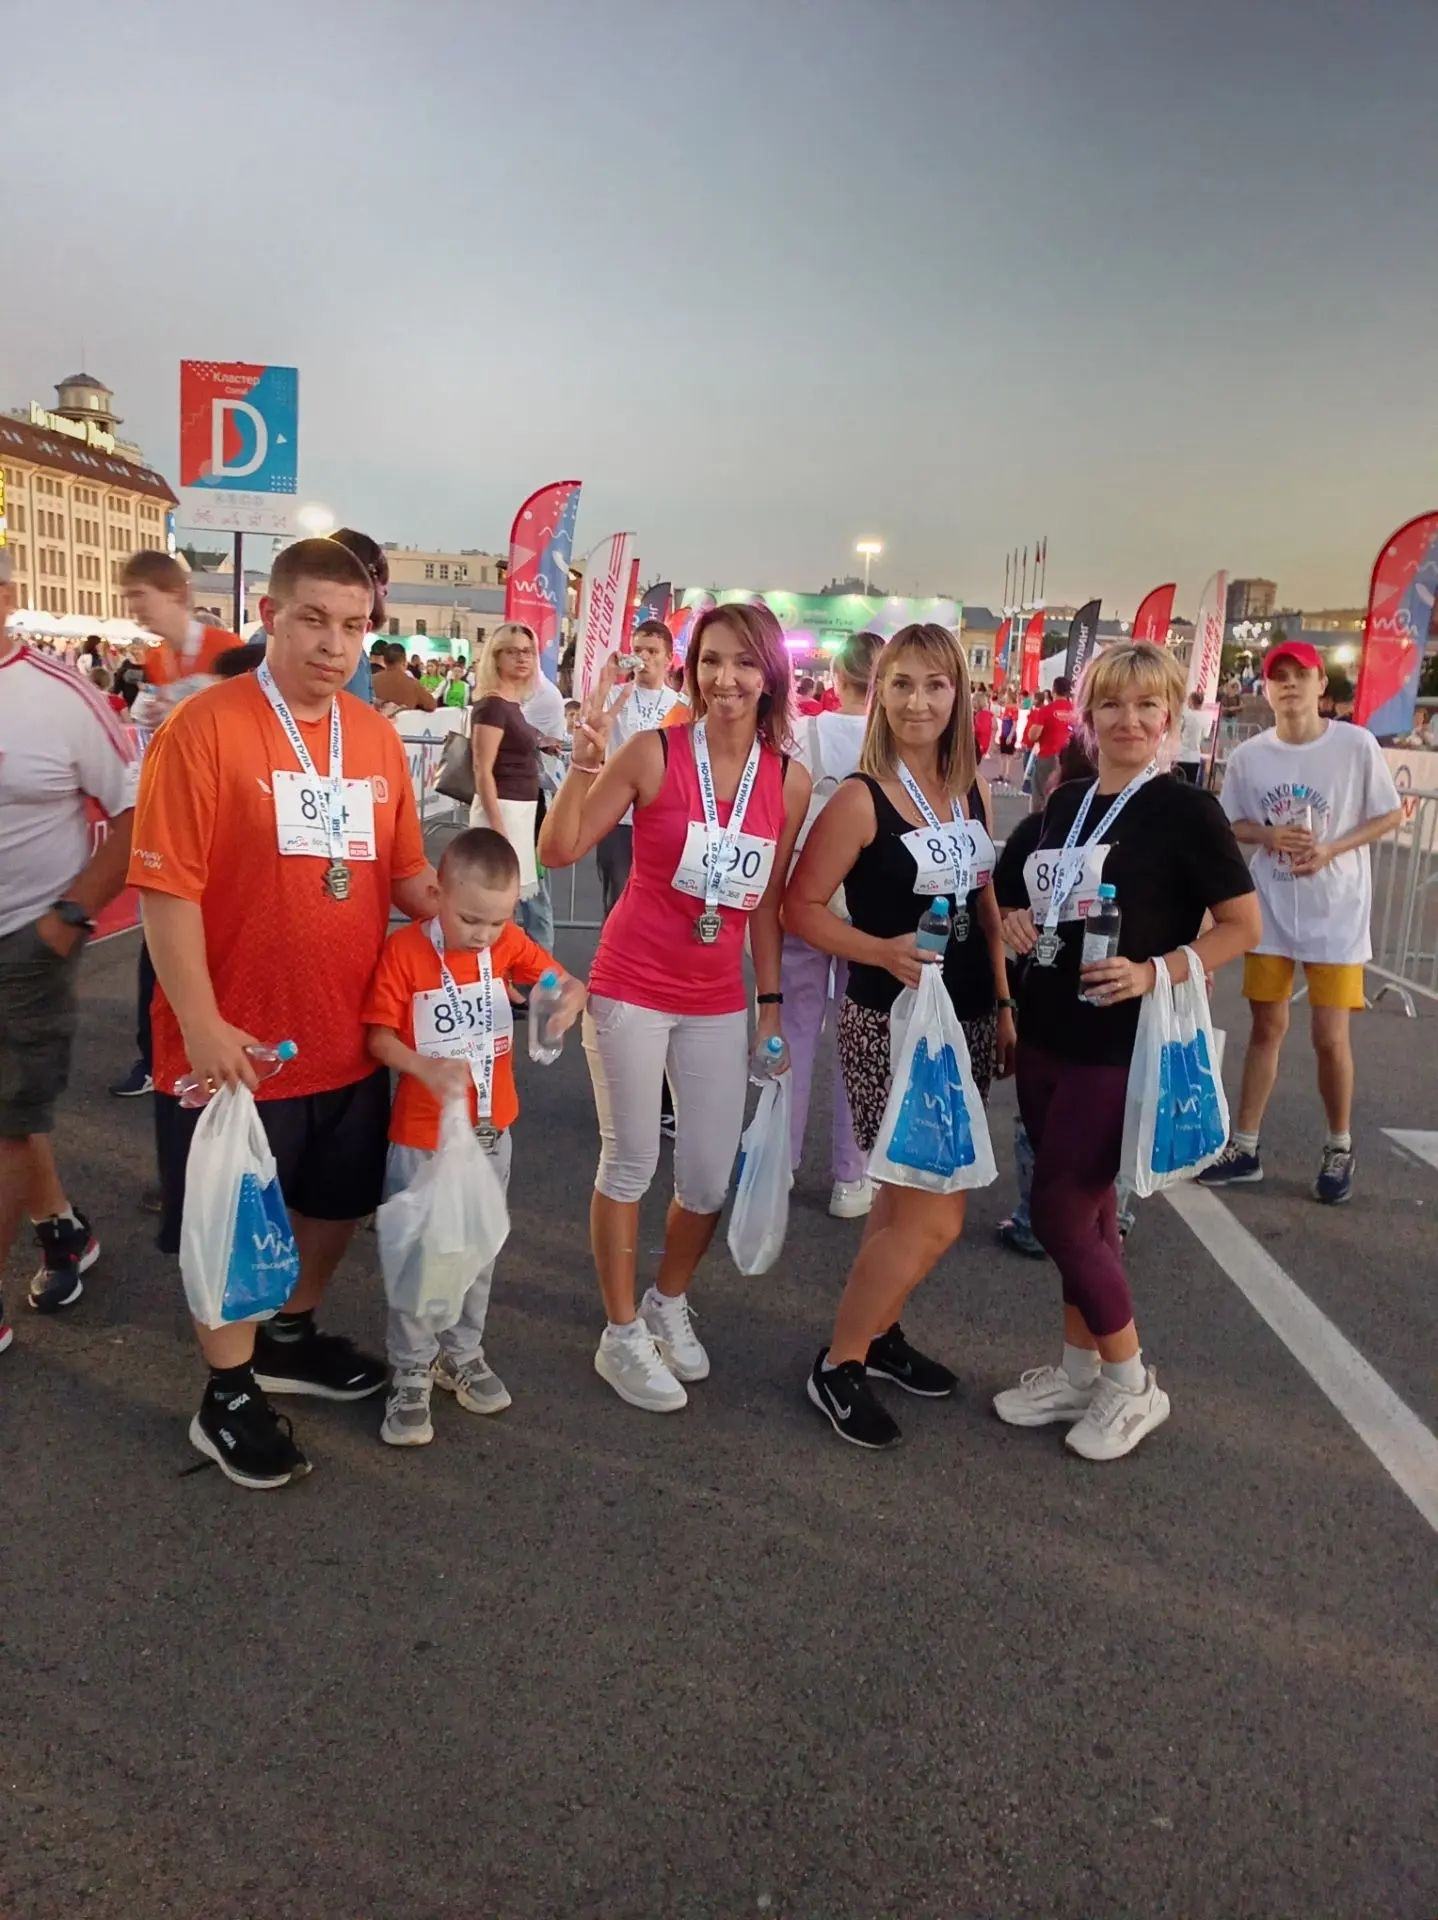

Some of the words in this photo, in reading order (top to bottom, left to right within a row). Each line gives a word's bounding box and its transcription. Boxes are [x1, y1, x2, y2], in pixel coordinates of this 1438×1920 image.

[212, 372, 261, 386] Кластер
[211, 398, 268, 478] D
[584, 577, 604, 673] RUNNERS
[598, 593, 615, 649] CLUB
[275, 703, 301, 743] НОЧНАЯ
[296, 743, 312, 768] ТУЛА
[700, 761, 714, 798] НОЧНАЯ
[734, 783, 750, 818] НОЧНАЯ
[743, 761, 756, 783] ТУЛА
[706, 799, 717, 822] ТУЛА
[702, 843, 760, 879] 90
[446, 985, 465, 1025] НОЧНАЯ
[482, 967, 492, 1007] НОЧНАЯ
[484, 1008, 493, 1033] ТУЛА
